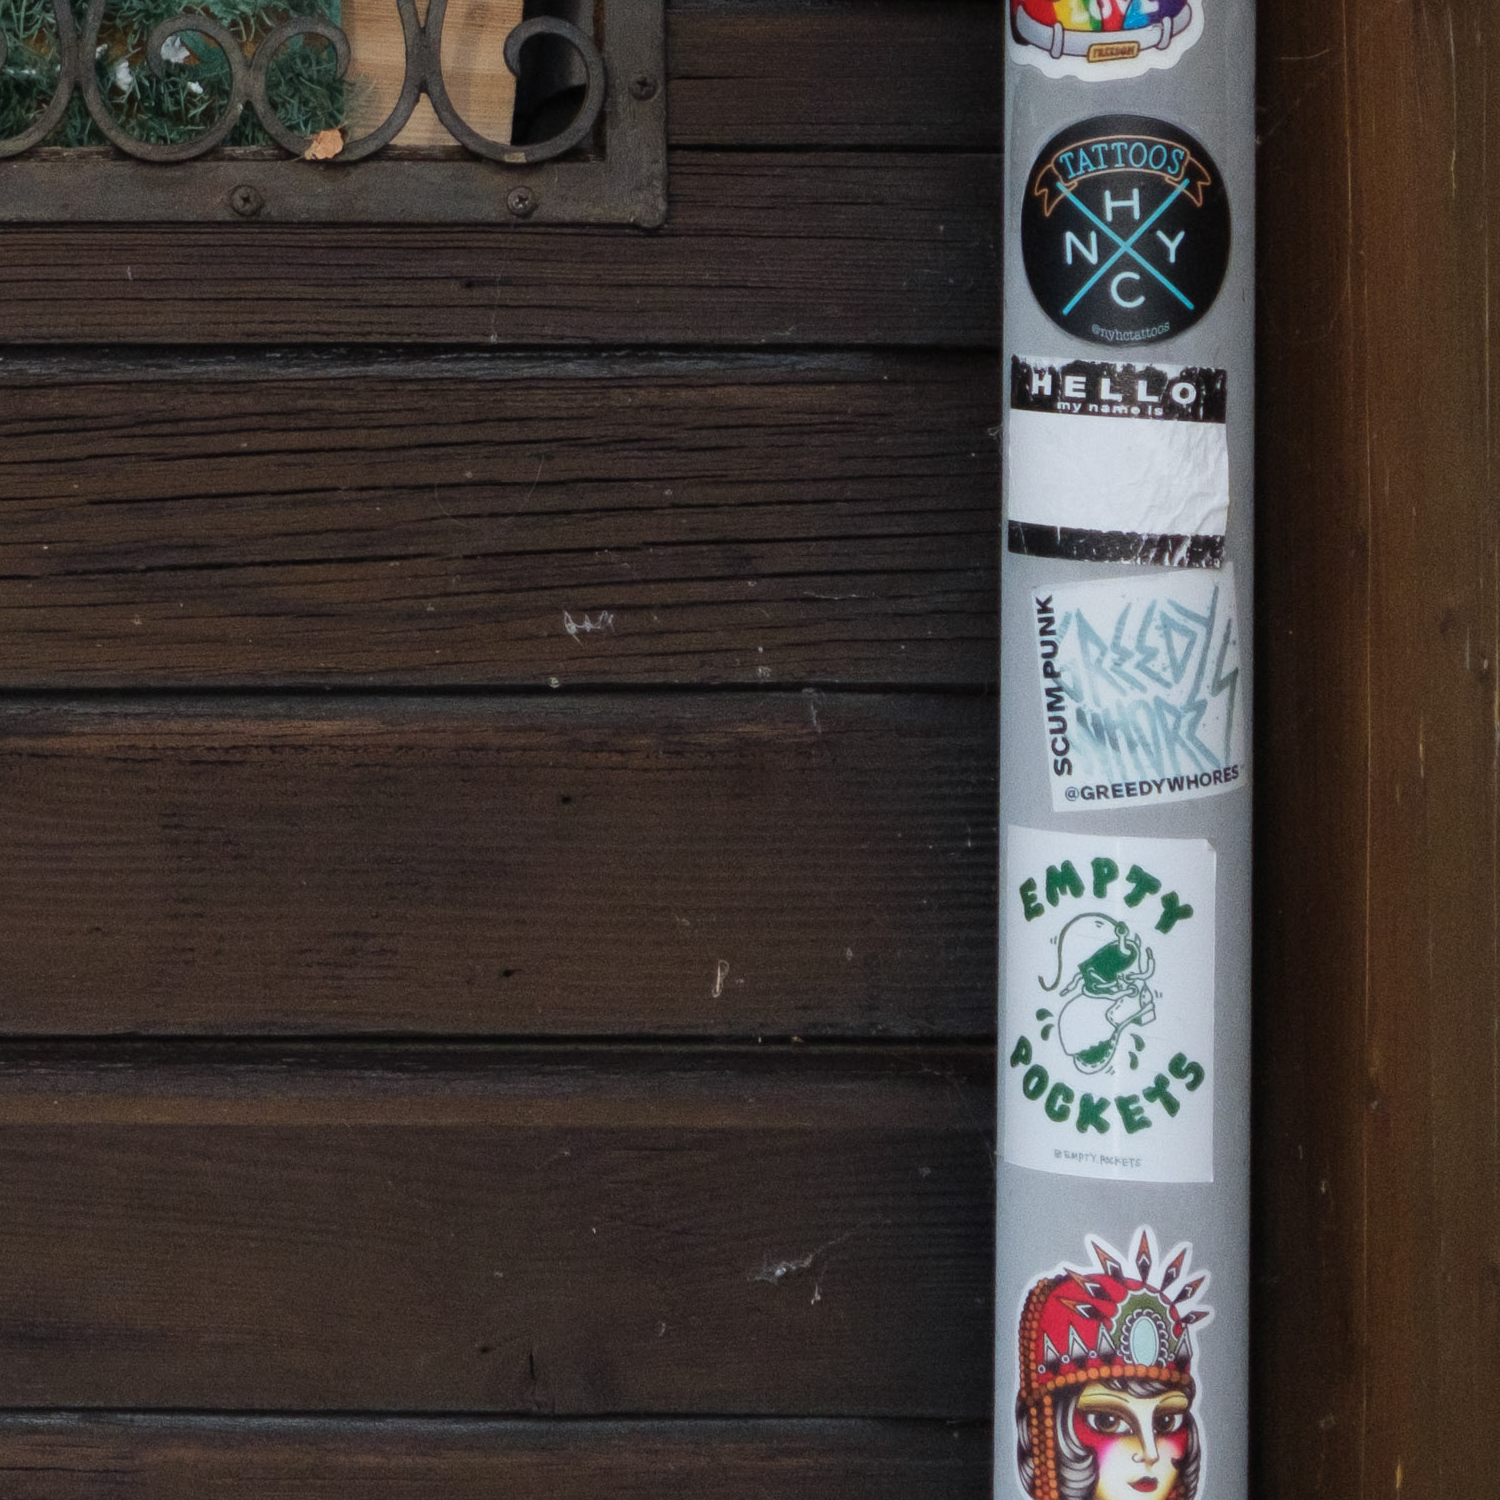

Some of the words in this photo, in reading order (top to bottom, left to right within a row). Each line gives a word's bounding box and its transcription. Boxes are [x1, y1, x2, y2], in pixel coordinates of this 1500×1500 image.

[1059, 141, 1185, 179] TATTOOS
[1104, 188, 1141, 222] H
[1065, 230, 1099, 266] N
[1156, 230, 1186, 264] Y
[1110, 271, 1146, 309] C
[1091, 321, 1171, 343] @nyhctattoos
[1031, 370, 1197, 405] HELLO
[1057, 400, 1082, 413] my
[1088, 402, 1141, 415] name
[1035, 594, 1062, 680] PUNK
[1044, 685, 1074, 777] SCUM
[1064, 764, 1240, 802] @GREEDYWHORES
[1018, 856, 1194, 935] EMPTY
[1010, 1035, 1205, 1135] POCKETS
